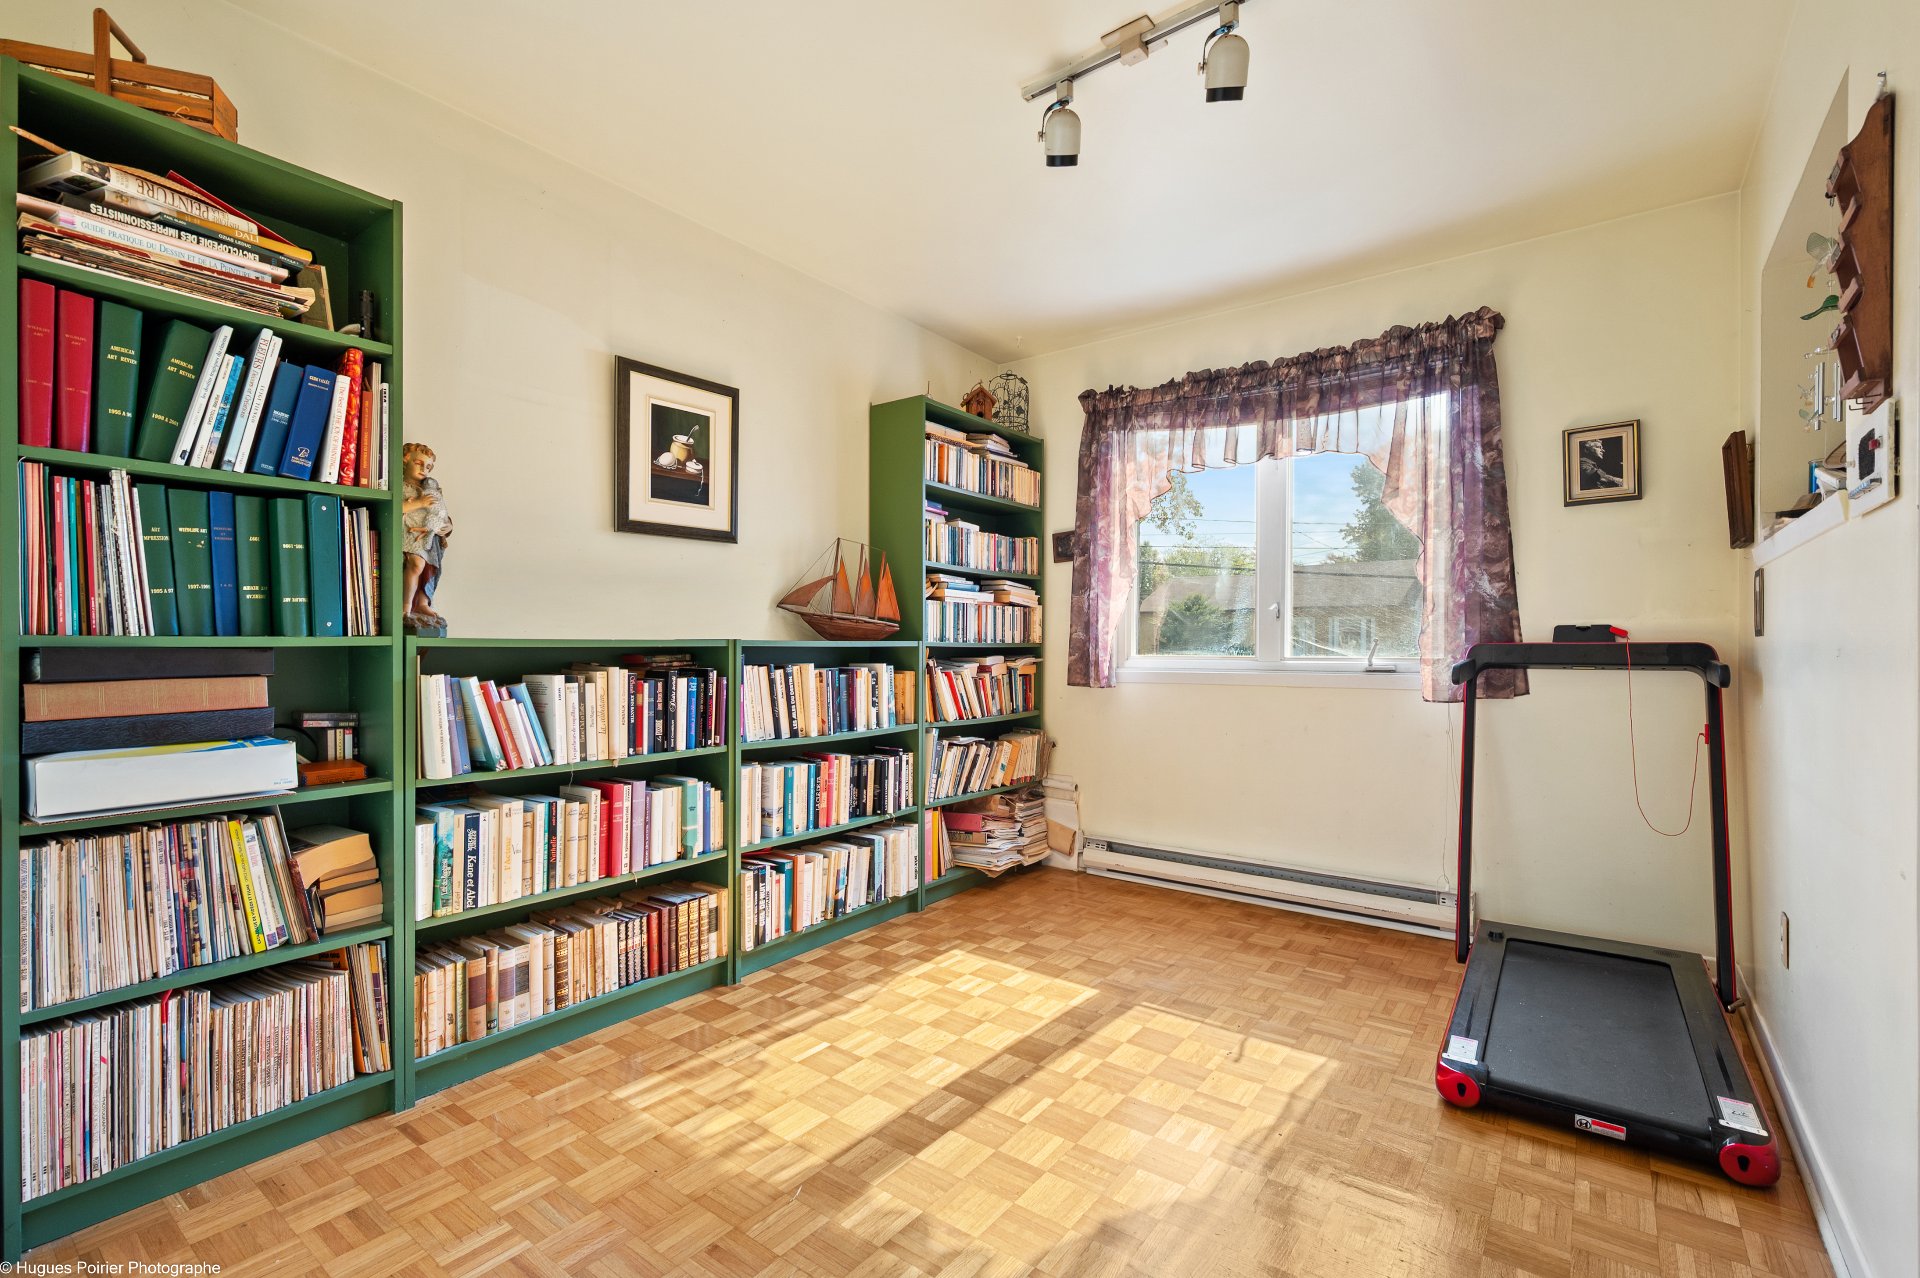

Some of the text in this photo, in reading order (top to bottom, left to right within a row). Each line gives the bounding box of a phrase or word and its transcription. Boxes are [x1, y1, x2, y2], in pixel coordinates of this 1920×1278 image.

[136, 178, 209, 221] PEINTURE
[90, 203, 179, 237] IMPRESSIONNISTES
[81, 220, 106, 236] GUIDE
[107, 226, 146, 248] PRATIQUE
[147, 239, 158, 250] DU
[180, 230, 198, 244] DES
[107, 353, 138, 365] ART REVIEW
[110, 345, 136, 355] AMERICAN
[255, 338, 269, 370] FLEURS
[167, 365, 196, 380] ART REVIEW
[170, 357, 194, 370] AMERICAN
[466, 855, 477, 908] Kane et Abel
